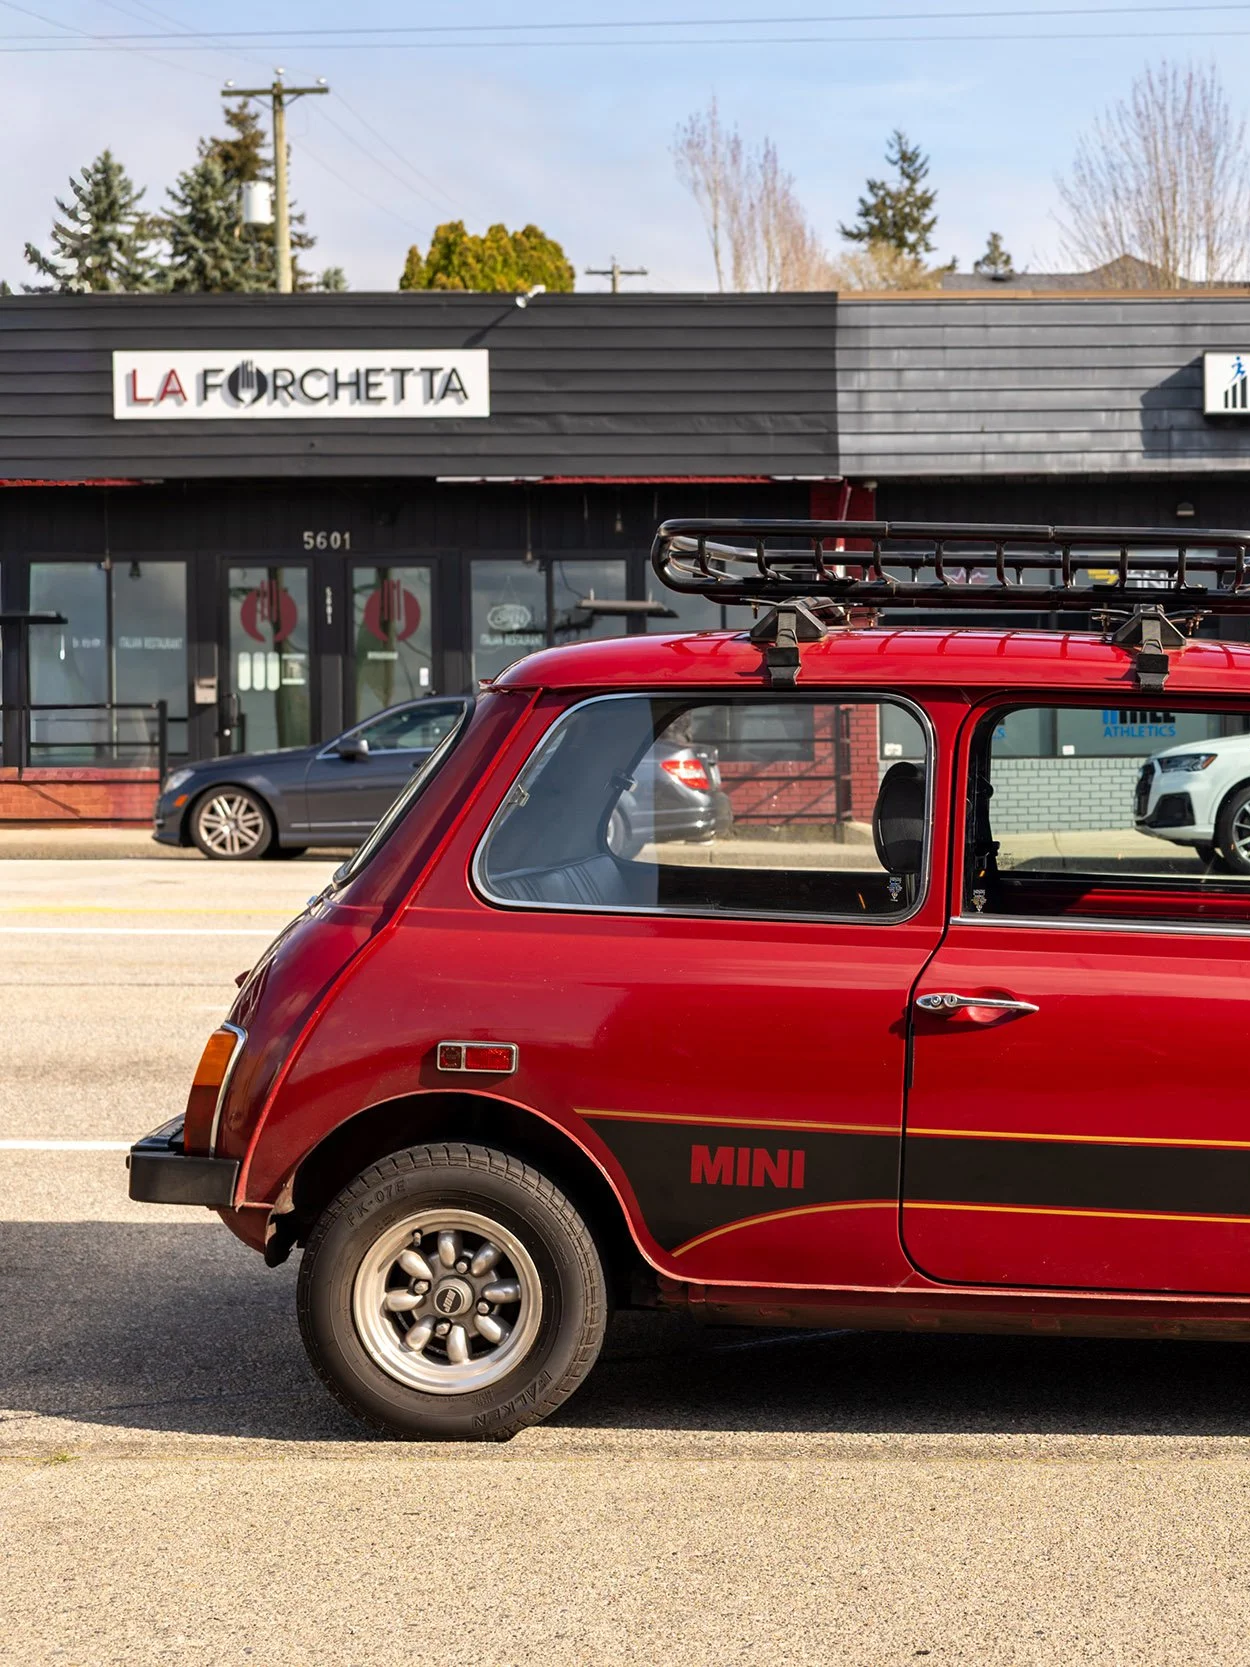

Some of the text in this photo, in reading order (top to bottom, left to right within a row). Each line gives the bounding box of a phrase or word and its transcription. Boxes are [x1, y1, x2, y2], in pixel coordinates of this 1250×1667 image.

[132, 360, 469, 404] LA FORCHETTA
[303, 531, 350, 550] 5601
[1103, 725, 1176, 738] ATHLETICS
[690, 1144, 805, 1189] MINI
[344, 1179, 406, 1227] FK-07E
[471, 1369, 553, 1429] FALKEN
